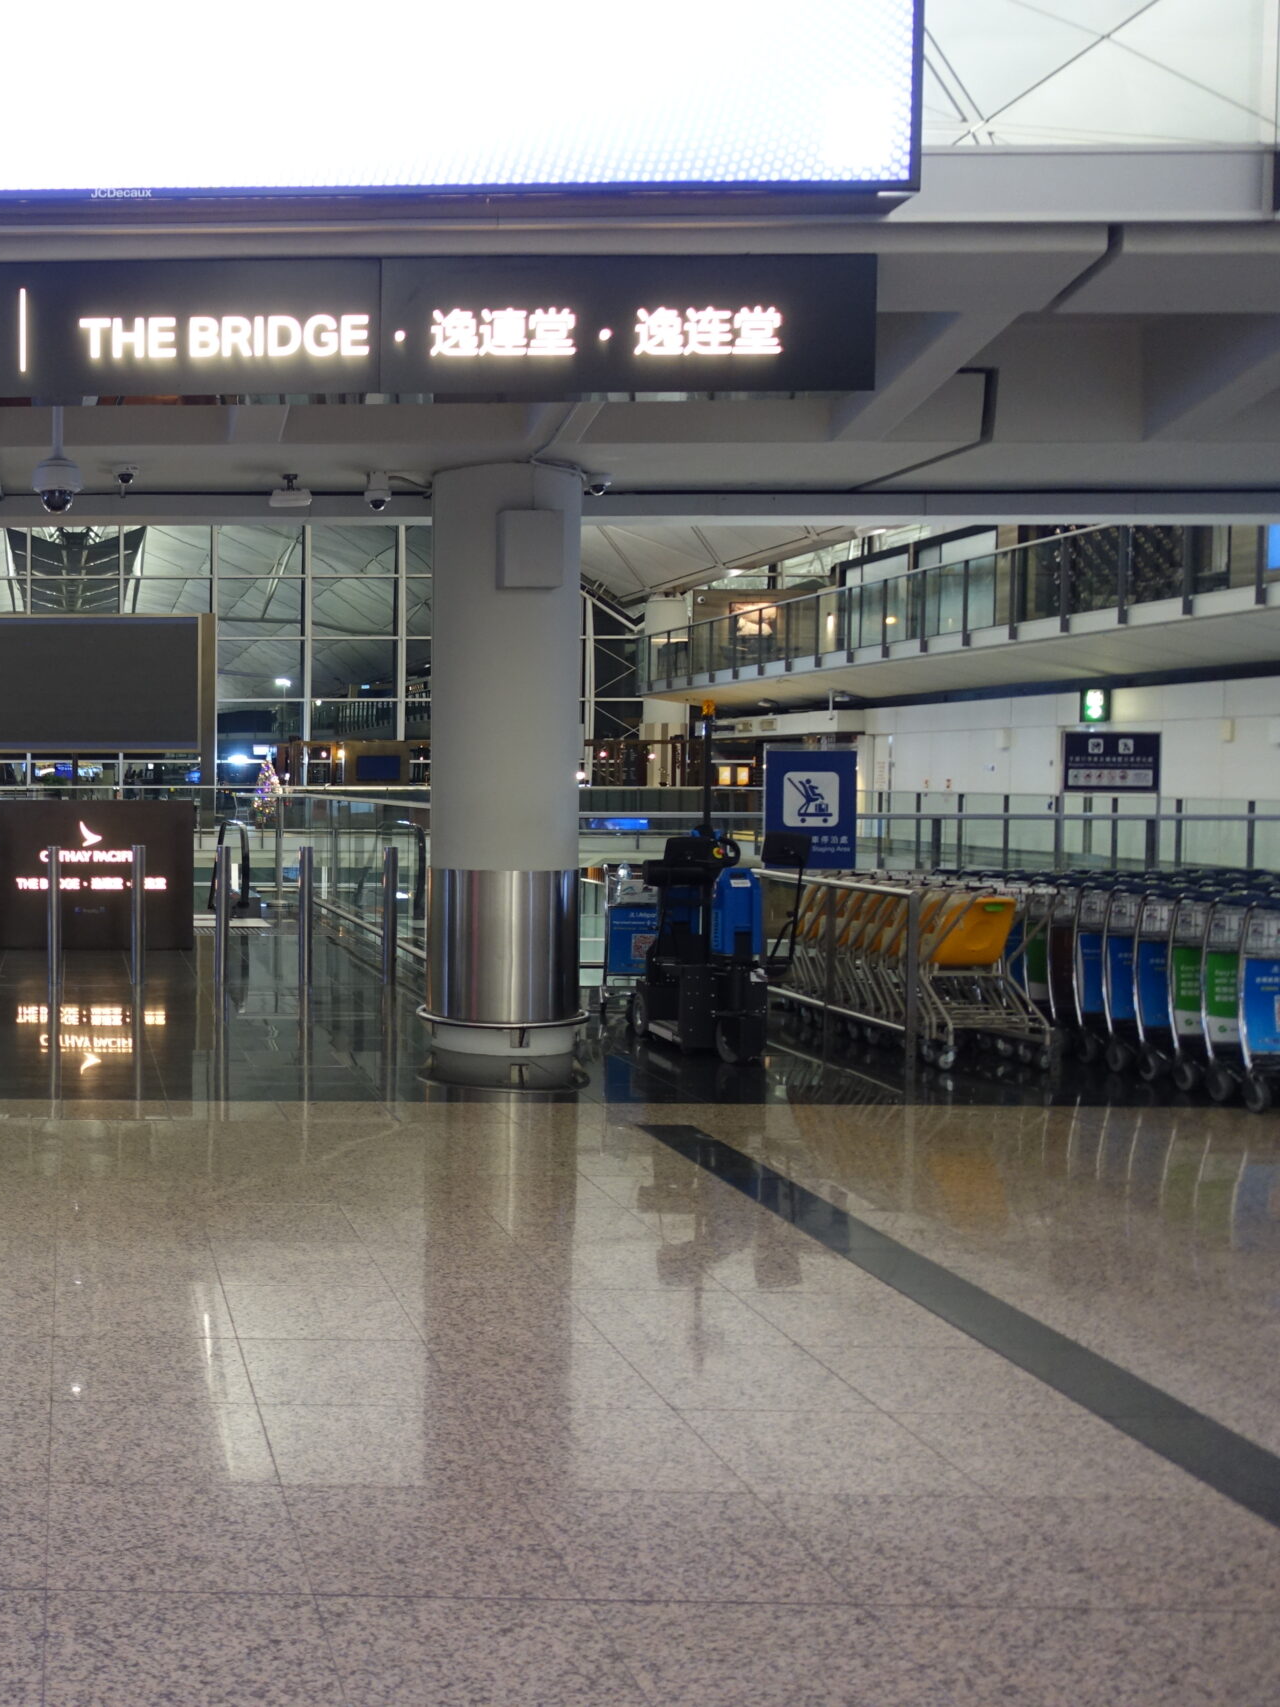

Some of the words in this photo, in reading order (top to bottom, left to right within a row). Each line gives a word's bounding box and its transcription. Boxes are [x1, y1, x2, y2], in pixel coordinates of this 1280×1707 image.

[91, 188, 152, 198] JCDecaux
[79, 317, 177, 359] THE
[189, 314, 369, 359] BRIDGE
[430, 307, 576, 357] 逸連堂
[634, 305, 782, 356] 逸连堂
[39, 849, 92, 863] CTHAY
[92, 849, 133, 863] PACIFI
[39, 877, 81, 890] BDGE
